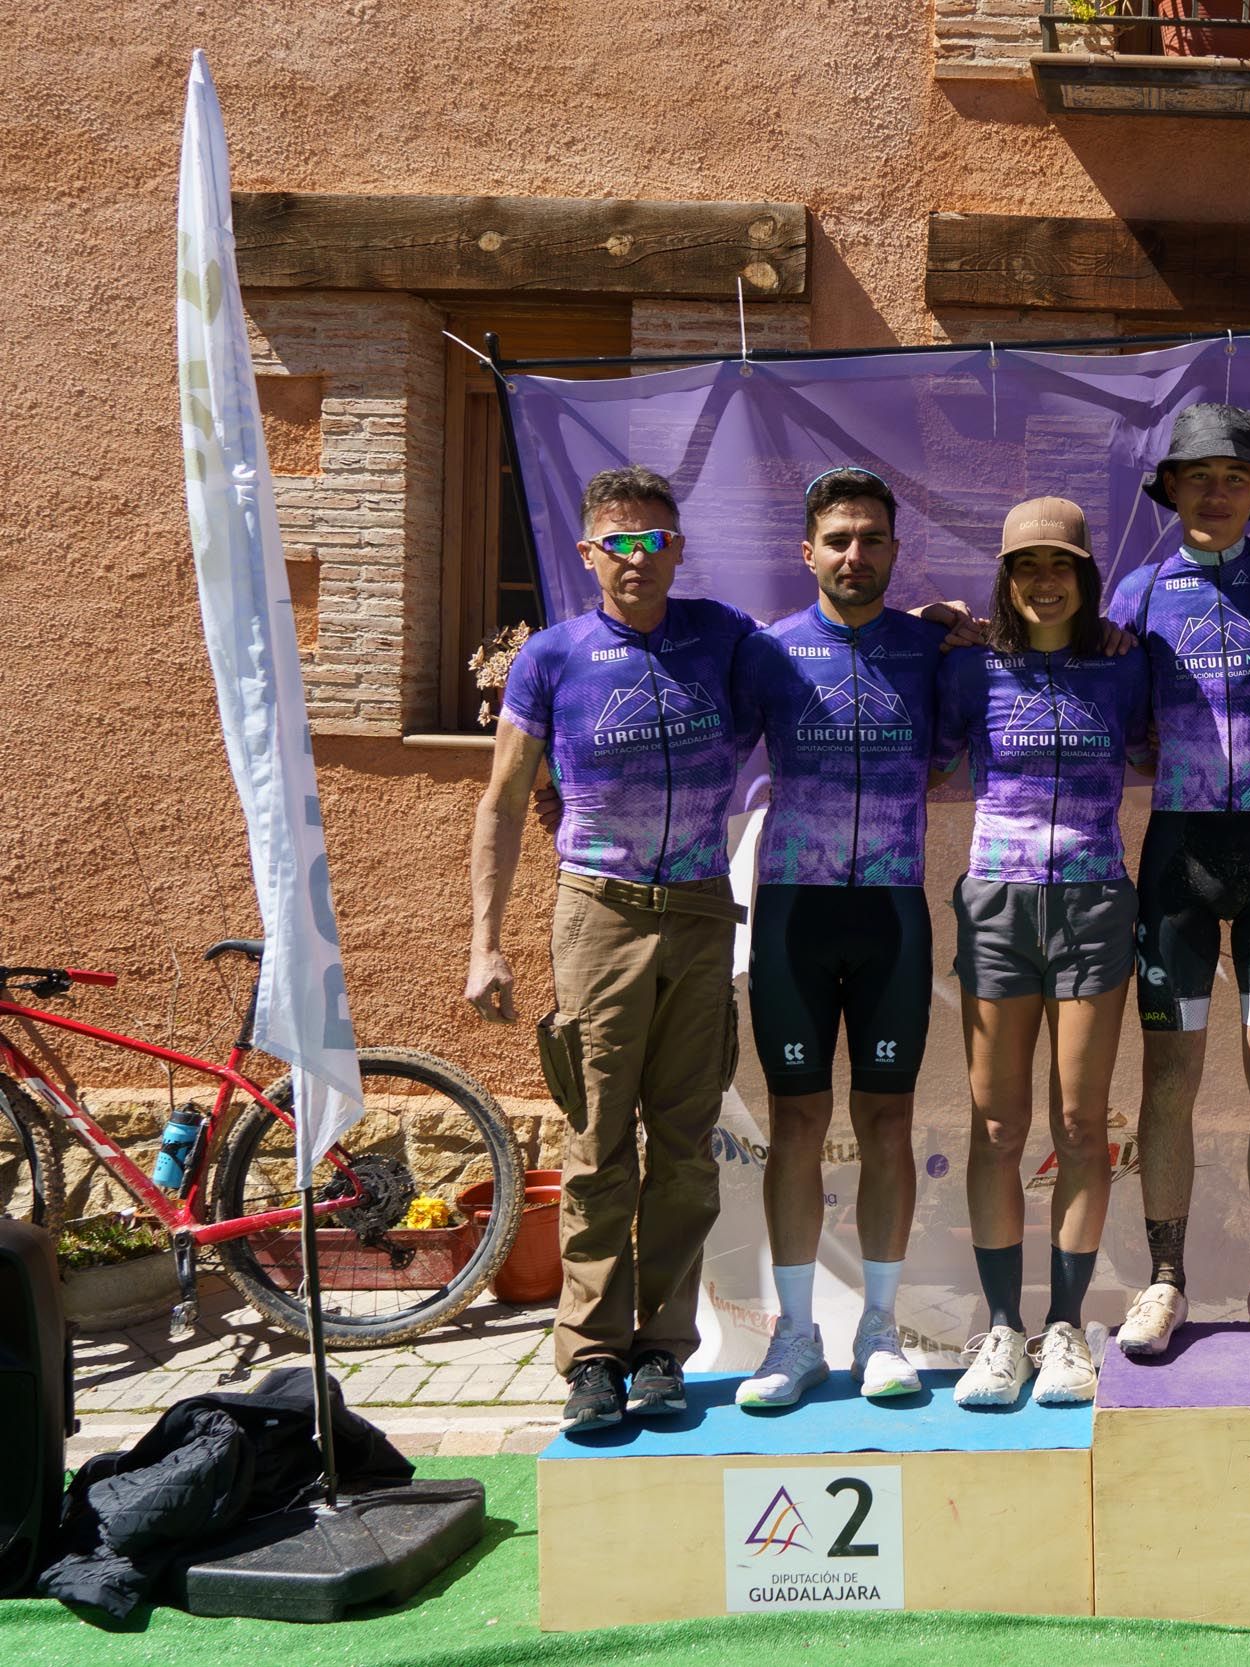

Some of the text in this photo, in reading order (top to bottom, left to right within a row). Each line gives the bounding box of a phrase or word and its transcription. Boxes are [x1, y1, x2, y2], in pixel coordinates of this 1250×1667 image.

[1020, 519, 1066, 530] DOG DAYS
[1165, 577, 1199, 591] GOBIK
[592, 646, 629, 662] GOBIK
[789, 646, 831, 657] GOBIK
[985, 658, 1026, 670] GOBIK
[1175, 655, 1242, 671] CIRCUITO
[593, 713, 721, 746] CIRCUITO MTB
[796, 729, 913, 741] CIRCUITO MTB
[651, 742, 663, 751] DE
[668, 731, 723, 748] GUADALAJARA
[1002, 734, 1111, 747] CIRCUITO MTB
[1060, 750, 1111, 758] GUADALAJARA
[825, 1476, 879, 1558] 2
[771, 1570, 859, 1585] DIPUTACIÓN DE
[749, 1585, 881, 1603] GUADALAJARA
